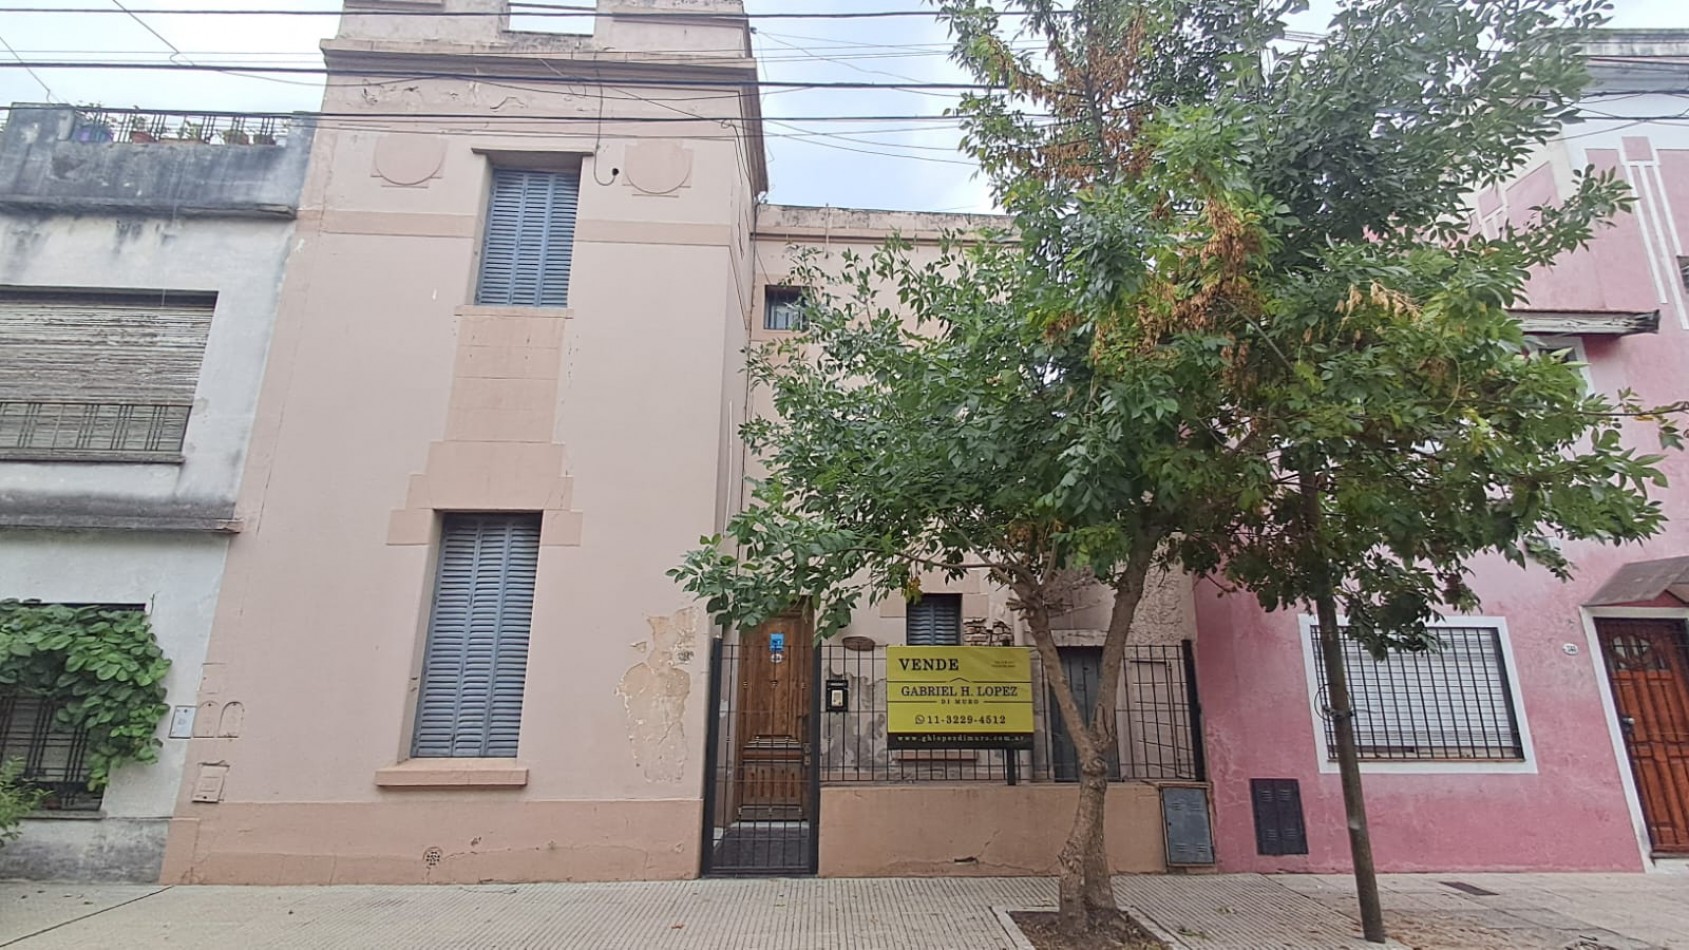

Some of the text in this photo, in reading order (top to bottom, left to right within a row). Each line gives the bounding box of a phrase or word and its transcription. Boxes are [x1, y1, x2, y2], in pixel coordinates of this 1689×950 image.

[898, 658, 960, 671] VENDE
[901, 686, 1018, 697] GABRIEL H. LOPEZ
[928, 714, 1006, 725] 11-3229-4512
